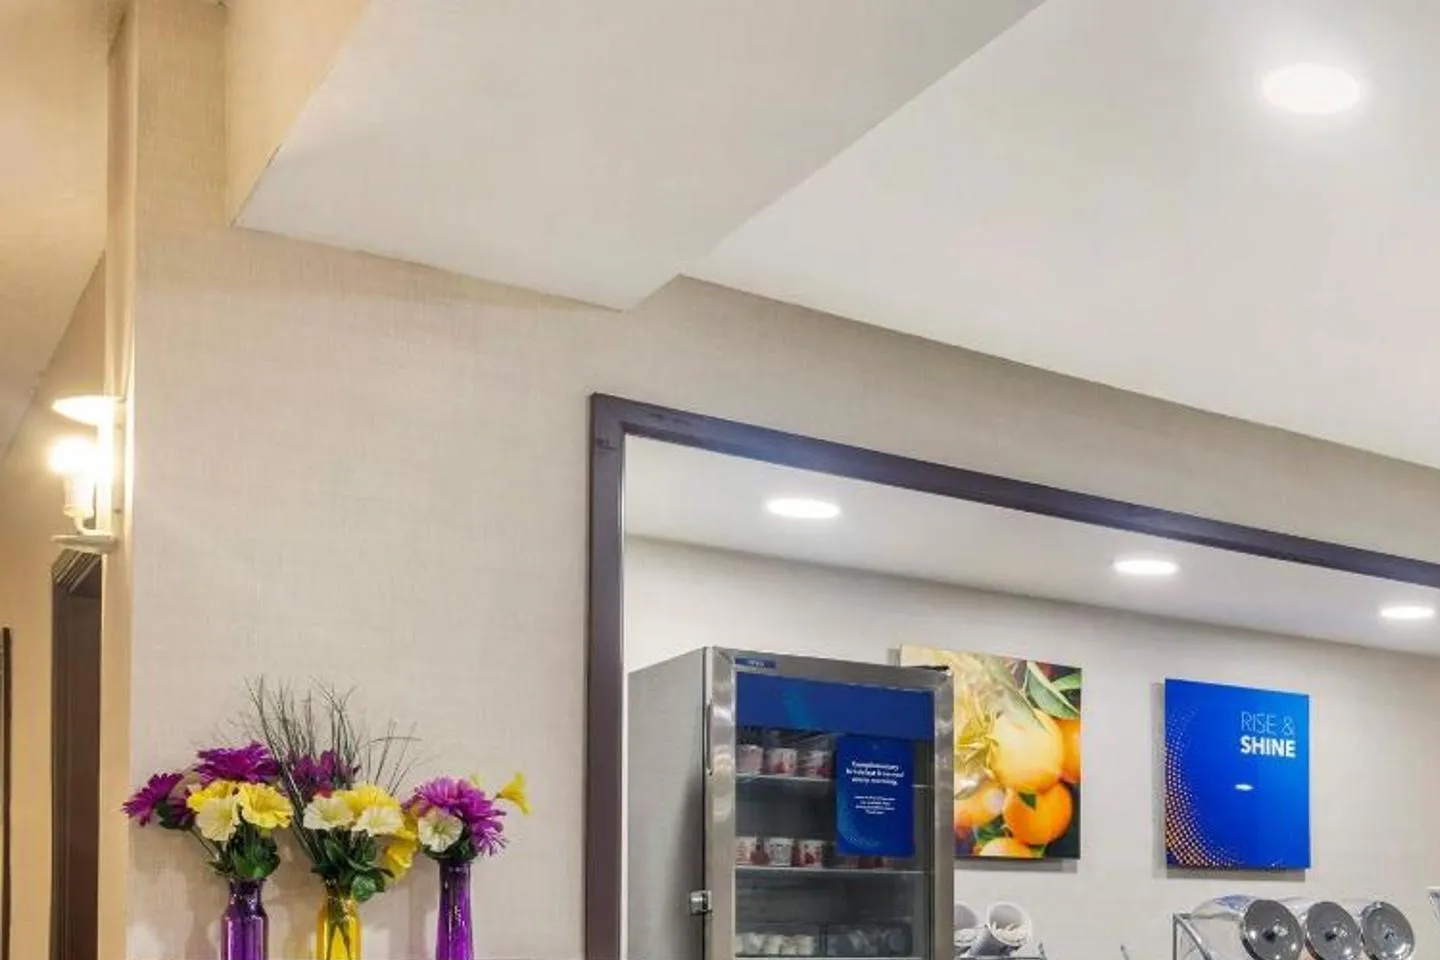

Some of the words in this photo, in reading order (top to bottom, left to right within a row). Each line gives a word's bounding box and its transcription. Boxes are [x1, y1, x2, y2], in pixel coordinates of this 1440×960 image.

[1240, 711, 1277, 735] RISE
[1281, 715, 1296, 737] &
[1240, 735, 1297, 758] SHINE
